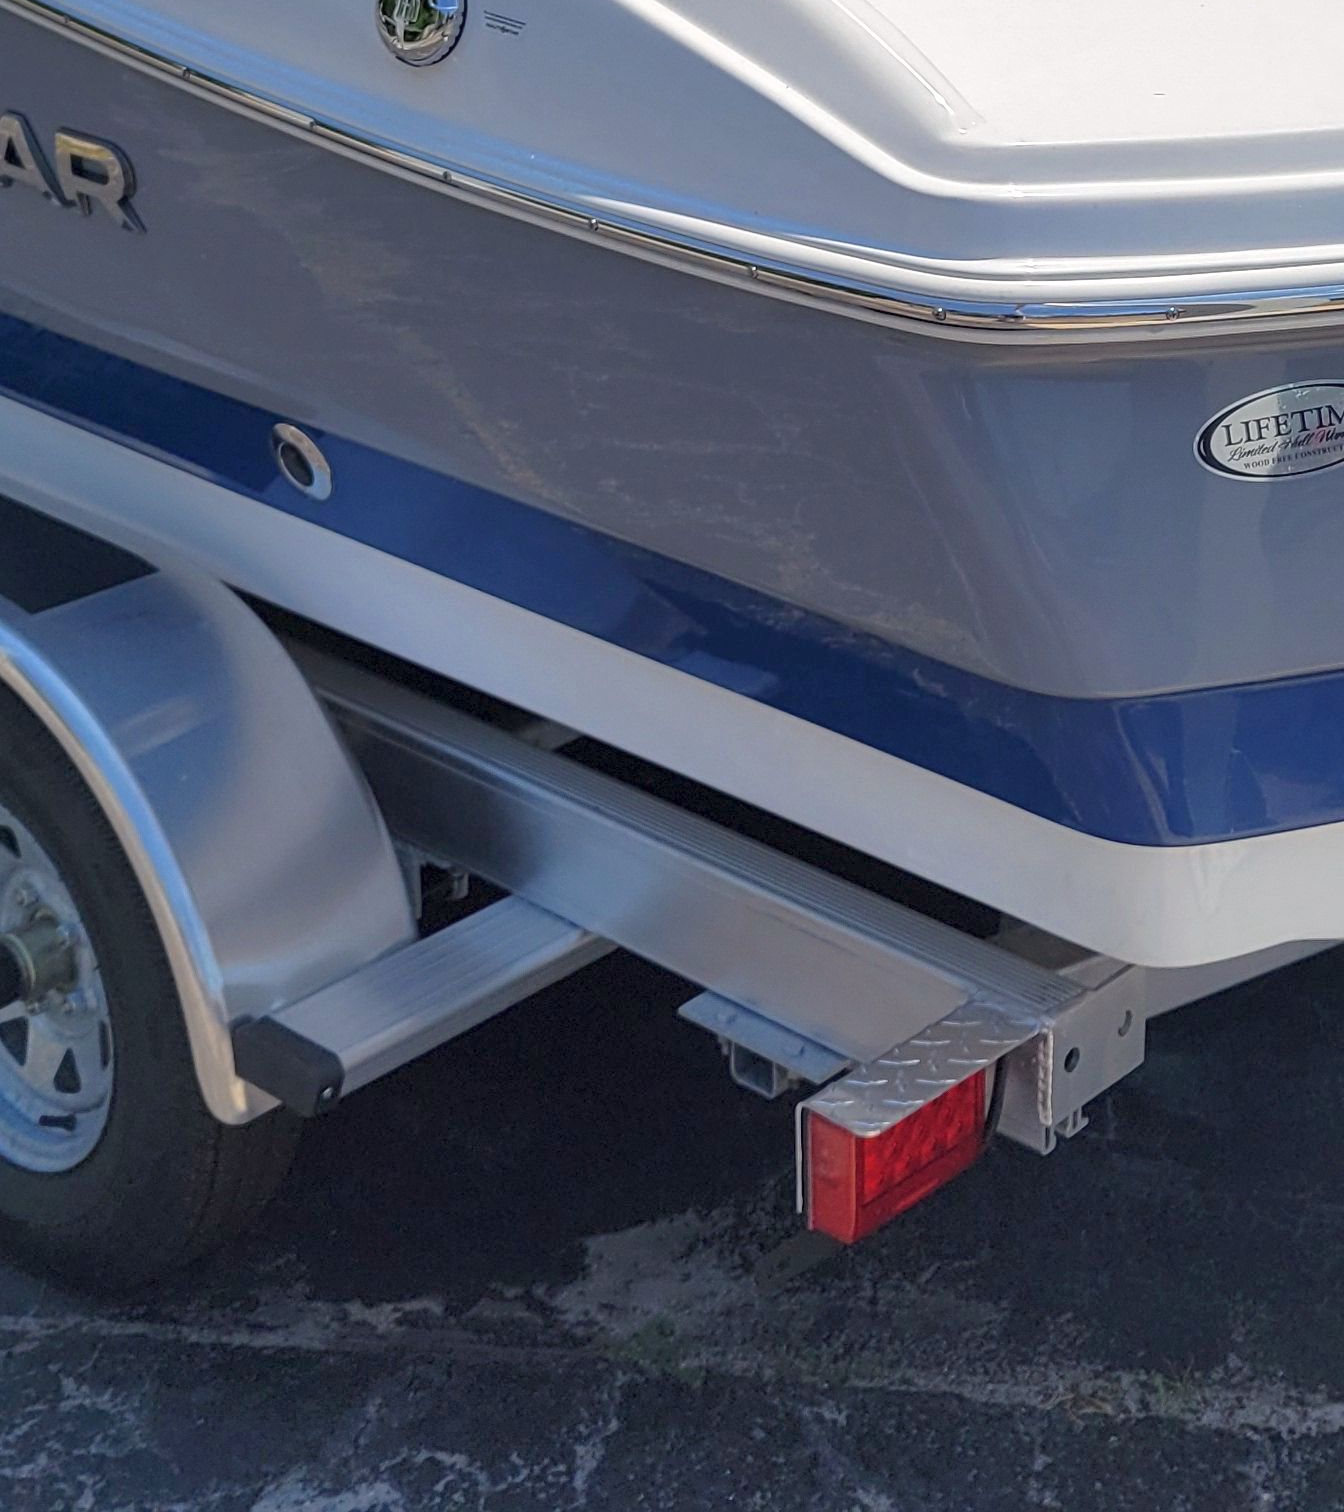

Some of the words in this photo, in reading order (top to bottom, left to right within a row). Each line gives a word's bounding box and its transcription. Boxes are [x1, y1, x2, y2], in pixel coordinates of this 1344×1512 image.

[1227, 443, 1277, 463] Limited
[1243, 458, 1270, 470] WOOD
[1271, 453, 1294, 465] FREE
